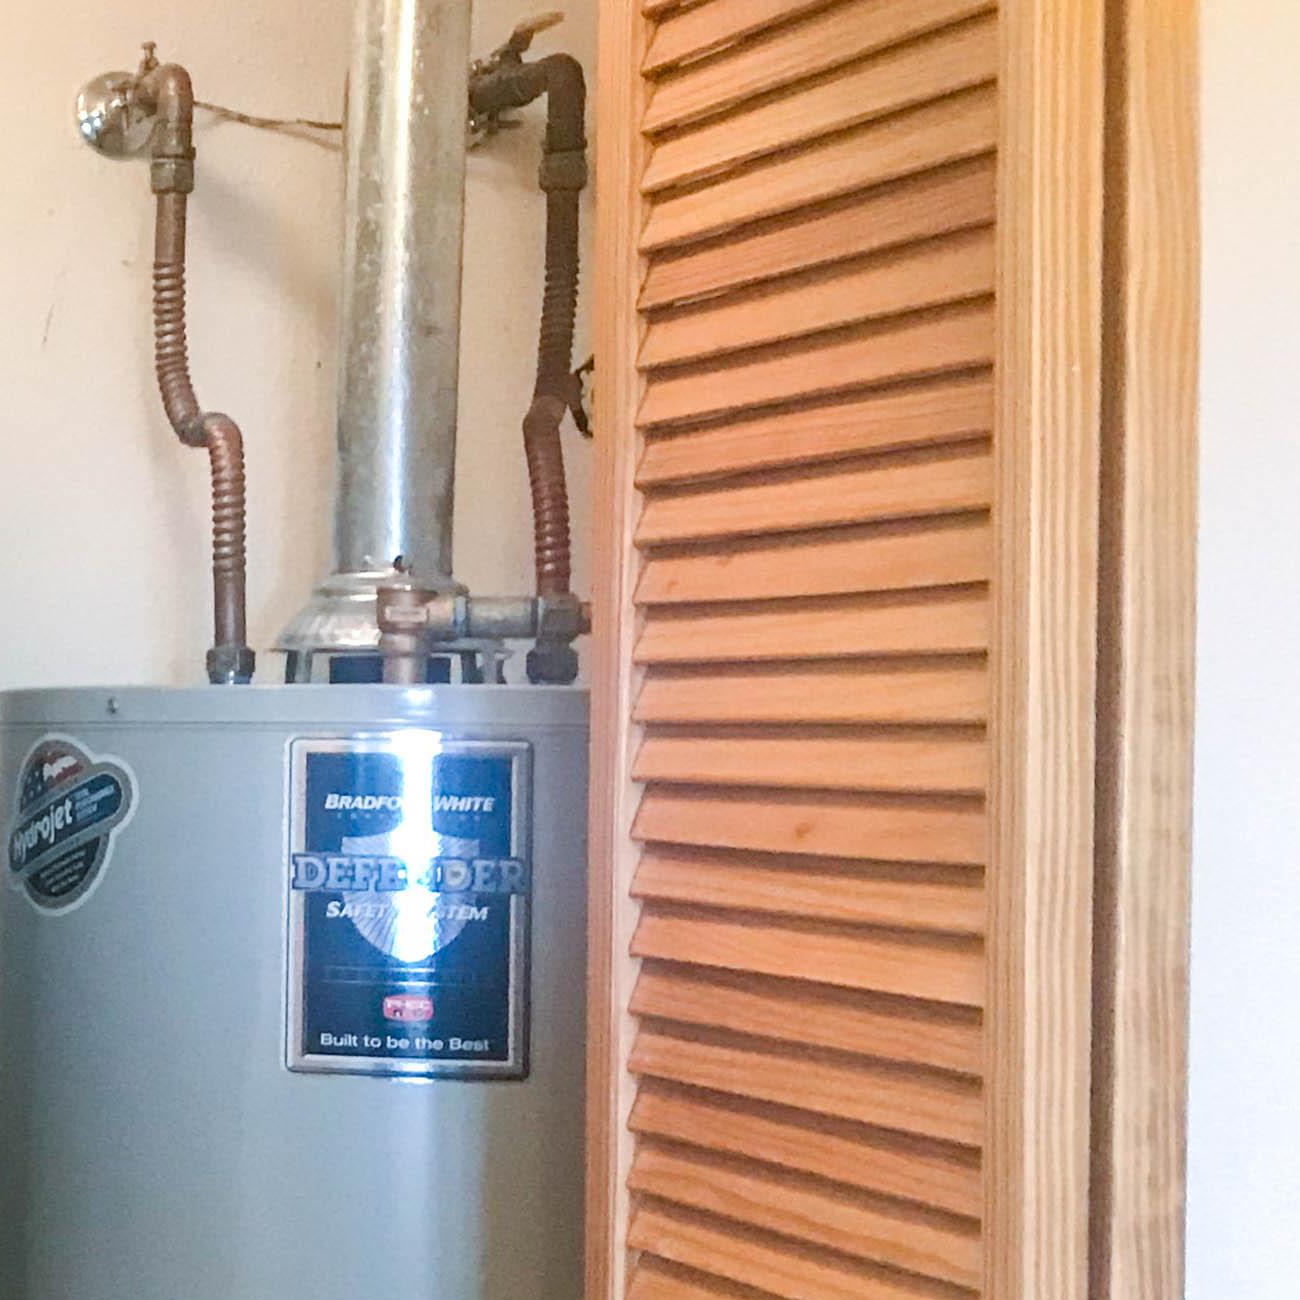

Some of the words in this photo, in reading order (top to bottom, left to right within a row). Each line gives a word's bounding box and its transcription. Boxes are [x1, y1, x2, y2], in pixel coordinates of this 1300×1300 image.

[324, 793, 412, 811] BRADFO
[433, 795, 495, 812] WHITE
[292, 853, 530, 894] DEFEDER
[325, 900, 395, 919] SAFET
[320, 1032, 358, 1047] Built
[364, 1034, 382, 1048] to
[386, 1035, 410, 1049] be
[415, 1037, 444, 1050] the
[450, 1037, 490, 1051] Best
